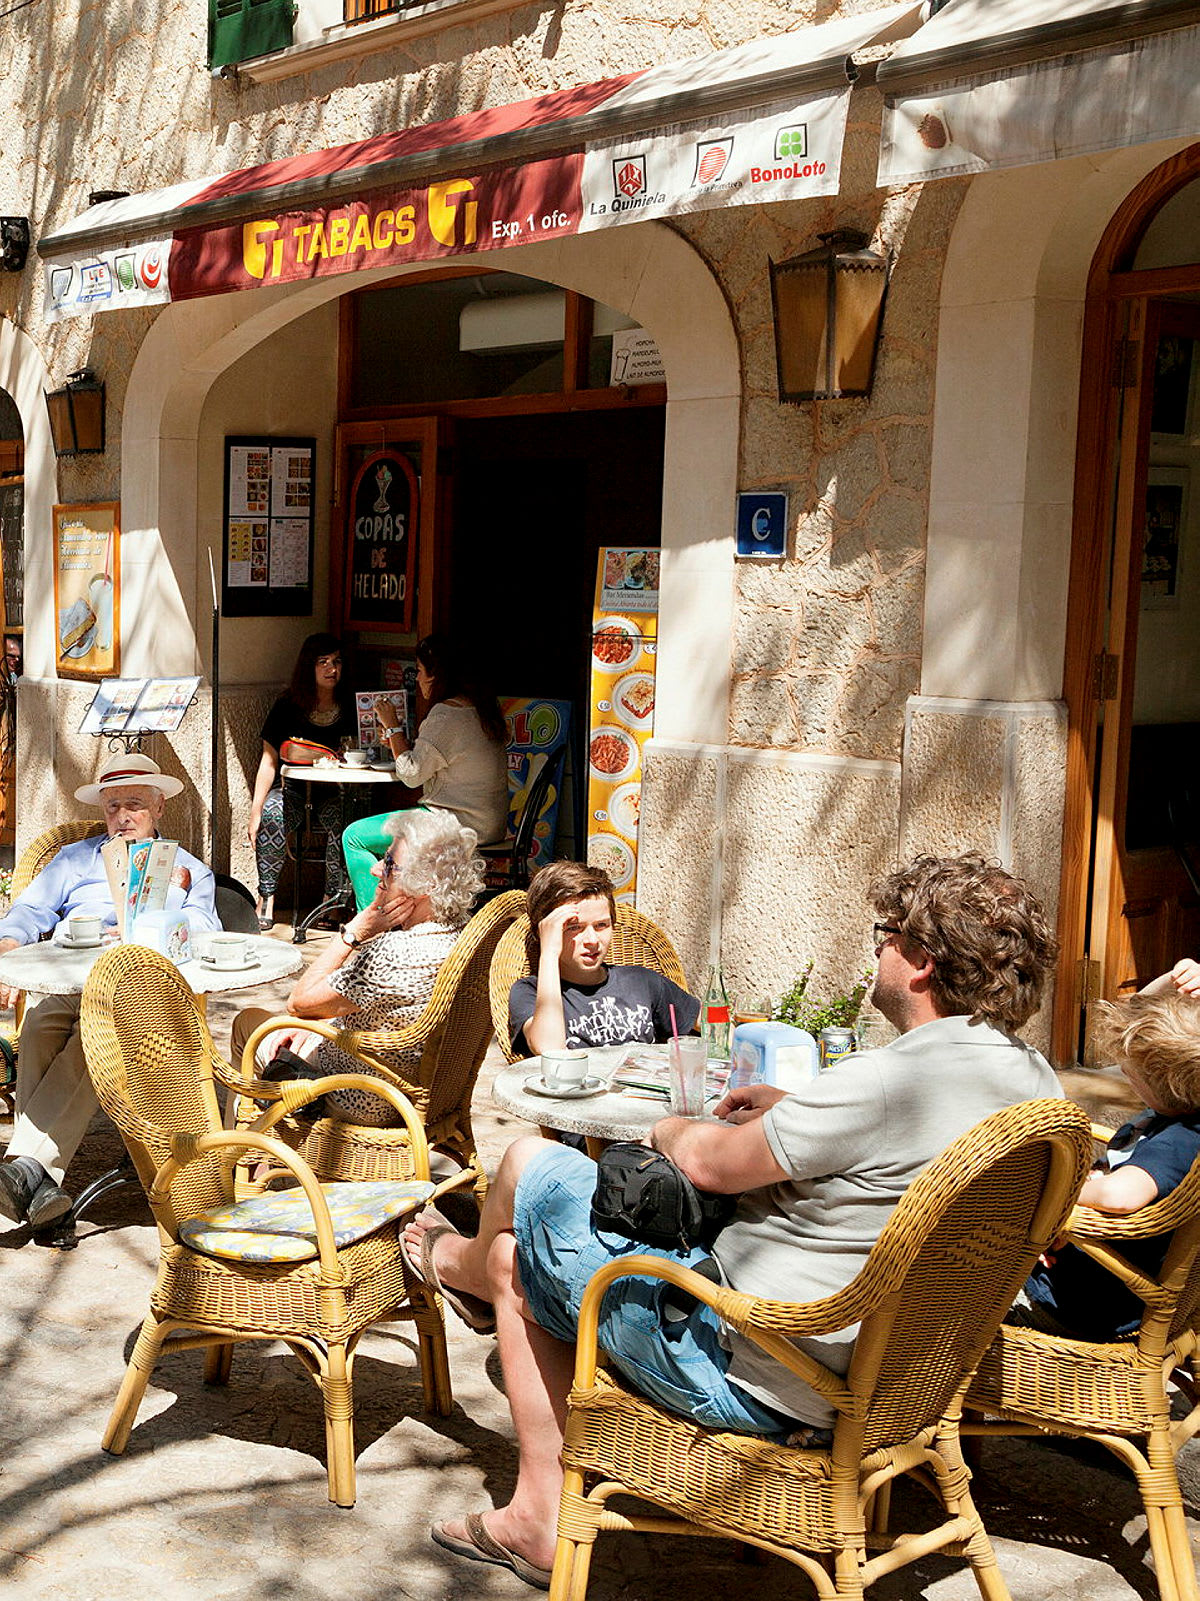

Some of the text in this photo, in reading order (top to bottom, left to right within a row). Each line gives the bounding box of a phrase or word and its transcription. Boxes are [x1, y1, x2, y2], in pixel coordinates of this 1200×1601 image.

[750, 160, 826, 184] BonoLoto
[590, 202, 606, 216] La
[611, 192, 666, 212] Quiniela
[293, 204, 417, 264] TABACS
[492, 210, 572, 241] Exp. 1 ofc.
[355, 513, 406, 542] COPAS
[370, 547, 388, 569] DE
[354, 574, 407, 601] HELADO
